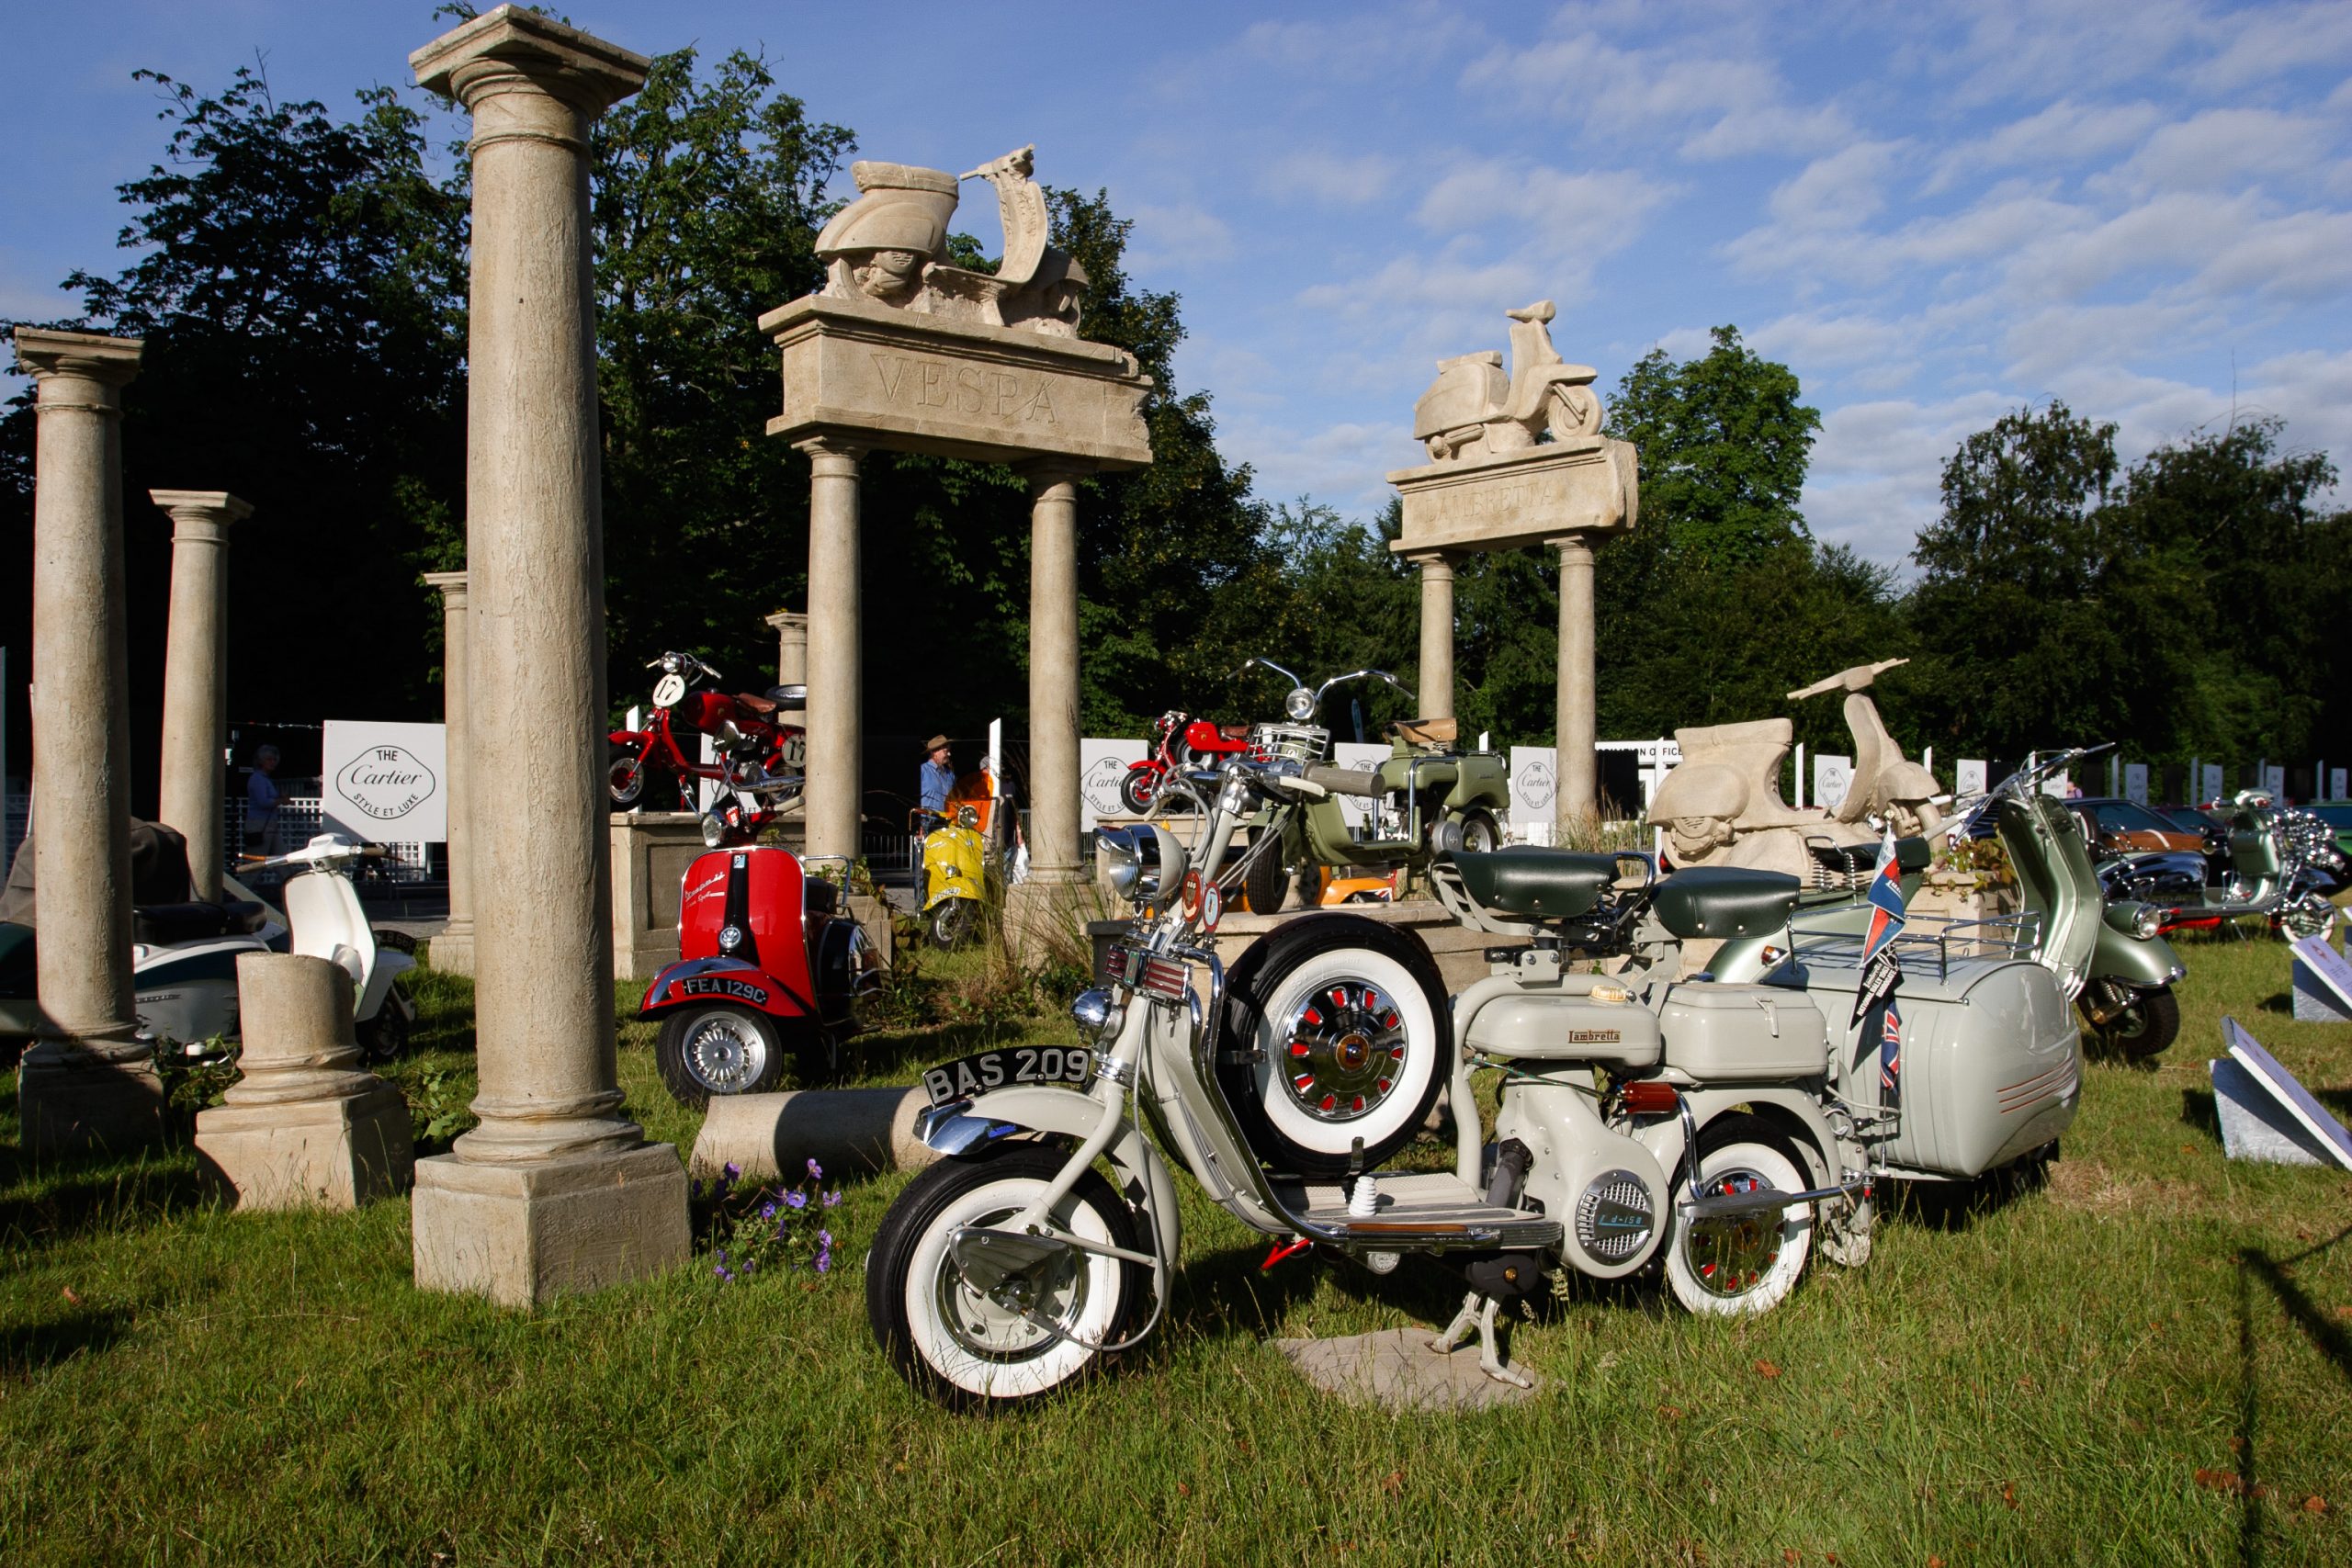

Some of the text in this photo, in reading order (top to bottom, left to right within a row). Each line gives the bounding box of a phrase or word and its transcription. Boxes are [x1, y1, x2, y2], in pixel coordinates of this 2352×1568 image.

[869, 353, 1056, 423] VESPA
[1425, 483, 1553, 524] LAMBRETTA
[656, 679, 677, 701] 17
[376, 750, 399, 761] THE
[1649, 747, 1683, 757] OFICE
[350, 763, 422, 784] Cartier
[1104, 761, 1118, 770] THE
[1361, 762, 1372, 772] THE
[1532, 764, 1542, 773] THE
[1088, 772, 1123, 788] Carti
[1521, 773, 1550, 787] Cartier
[353, 793, 419, 816] STYLE ET LUXE
[1090, 794, 1106, 811] STYLE
[686, 978, 766, 1004] FEA 129C
[1875, 968, 1898, 998] HARROGATE
[1856, 991, 1875, 1017] NATIONAL
[1869, 976, 1883, 993] RALLY
[1568, 1029, 1621, 1043] Lambretta
[924, 1048, 1090, 1104] BAS 209
